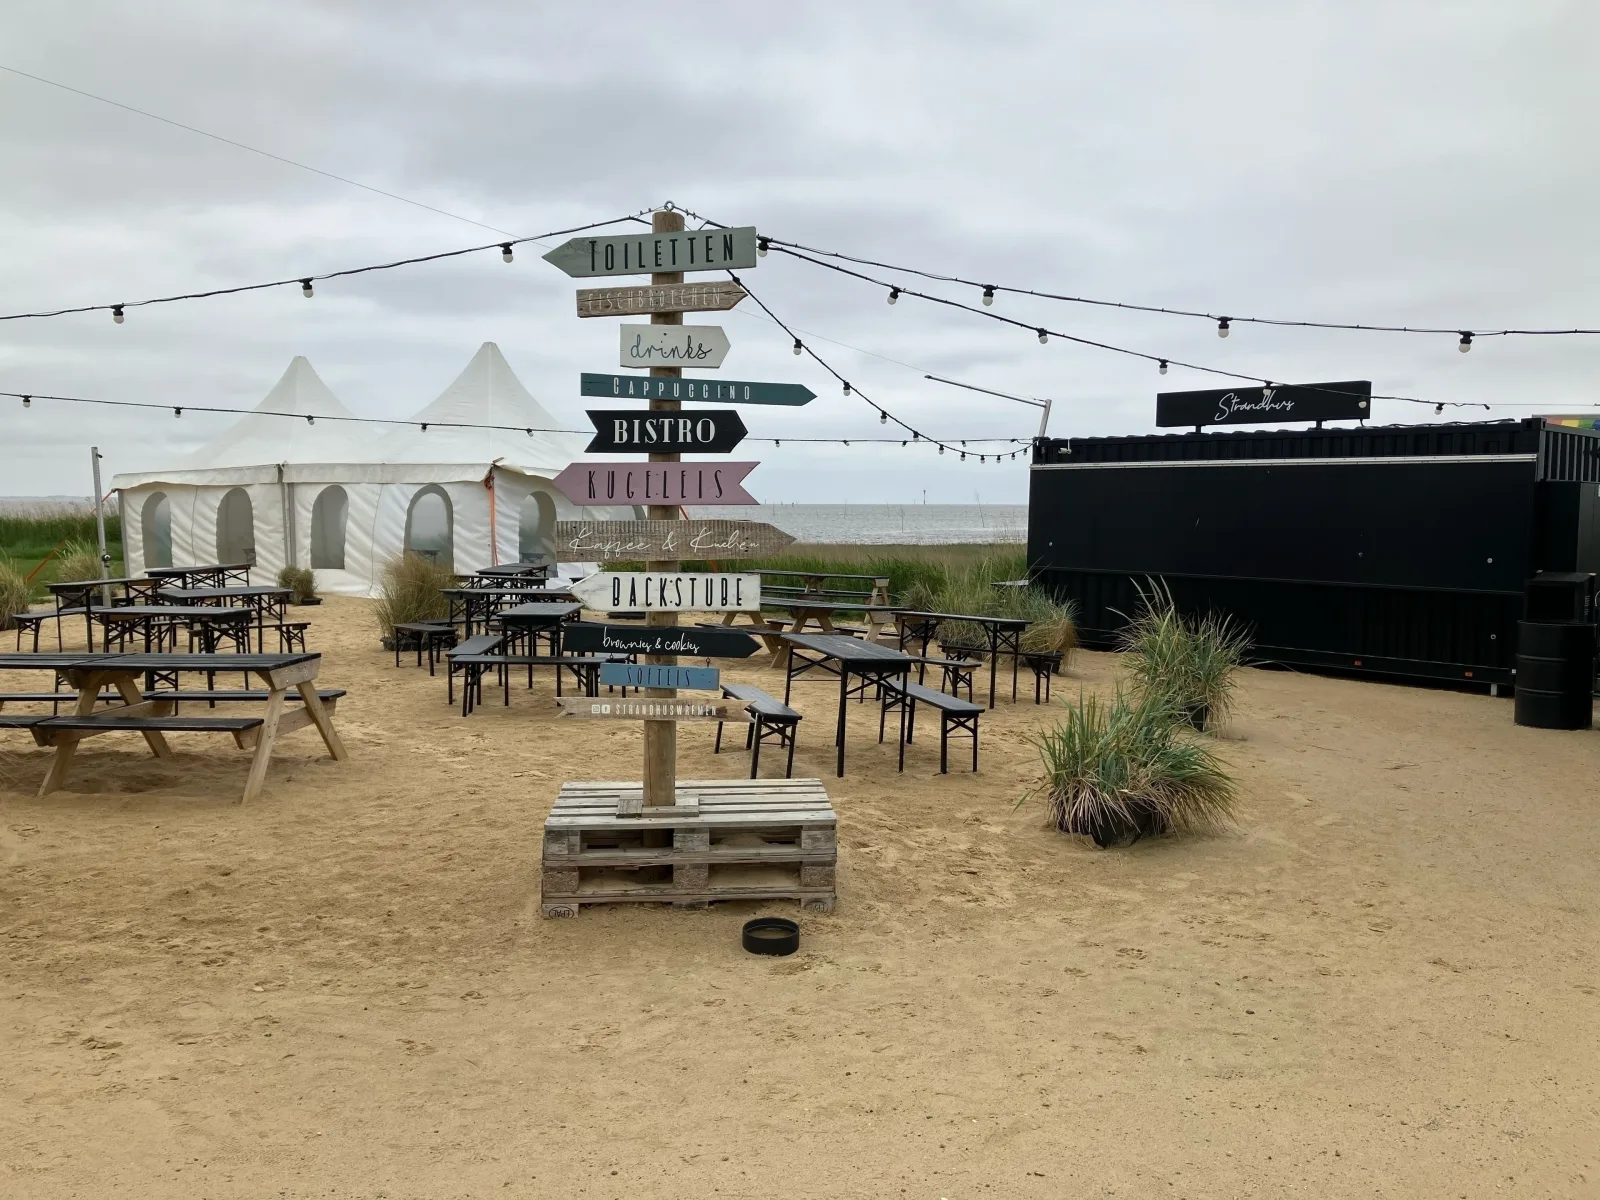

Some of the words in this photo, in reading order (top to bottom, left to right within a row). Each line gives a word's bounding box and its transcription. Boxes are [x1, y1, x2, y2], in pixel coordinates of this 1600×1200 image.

[588, 233, 735, 272] TOILETTEN
[630, 332, 713, 360] drinks
[613, 377, 750, 400] CAPPUCCINO
[1214, 392, 1295, 421] Strandhus
[613, 417, 716, 444] BISTRO
[588, 469, 723, 499] KUGELEIS
[569, 527, 652, 559] Kaffee
[661, 531, 678, 552] &
[690, 527, 760, 552] Kuchen
[612, 576, 743, 607] BACKSTUBE
[602, 626, 652, 652] brownies
[654, 637, 662, 649] &
[664, 632, 700, 654] cookies
[627, 667, 690, 687] SOFTEIS
